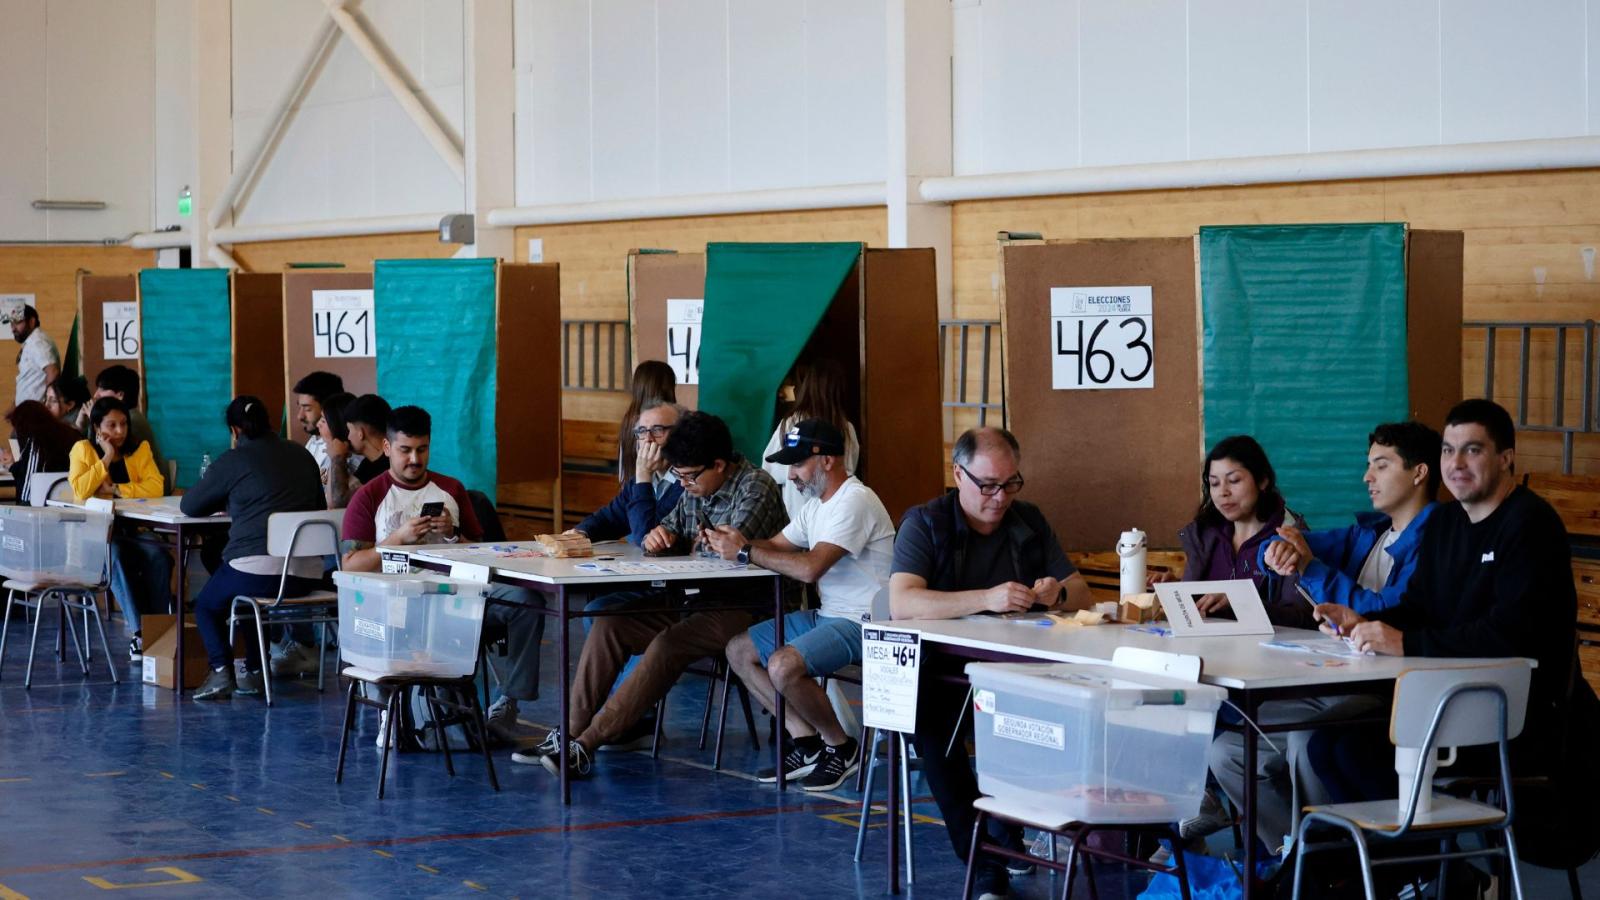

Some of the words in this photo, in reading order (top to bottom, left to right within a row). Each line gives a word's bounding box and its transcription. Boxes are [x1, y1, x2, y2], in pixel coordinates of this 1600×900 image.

[1087, 296, 1131, 304] ELECCIONES
[315, 310, 368, 356] 461
[669, 327, 700, 383] 4
[1057, 317, 1152, 385] 463
[892, 645, 916, 668] 464
[997, 724, 1032, 738] GOBERNADOR
[1003, 717, 1027, 729] SEGUNDA
